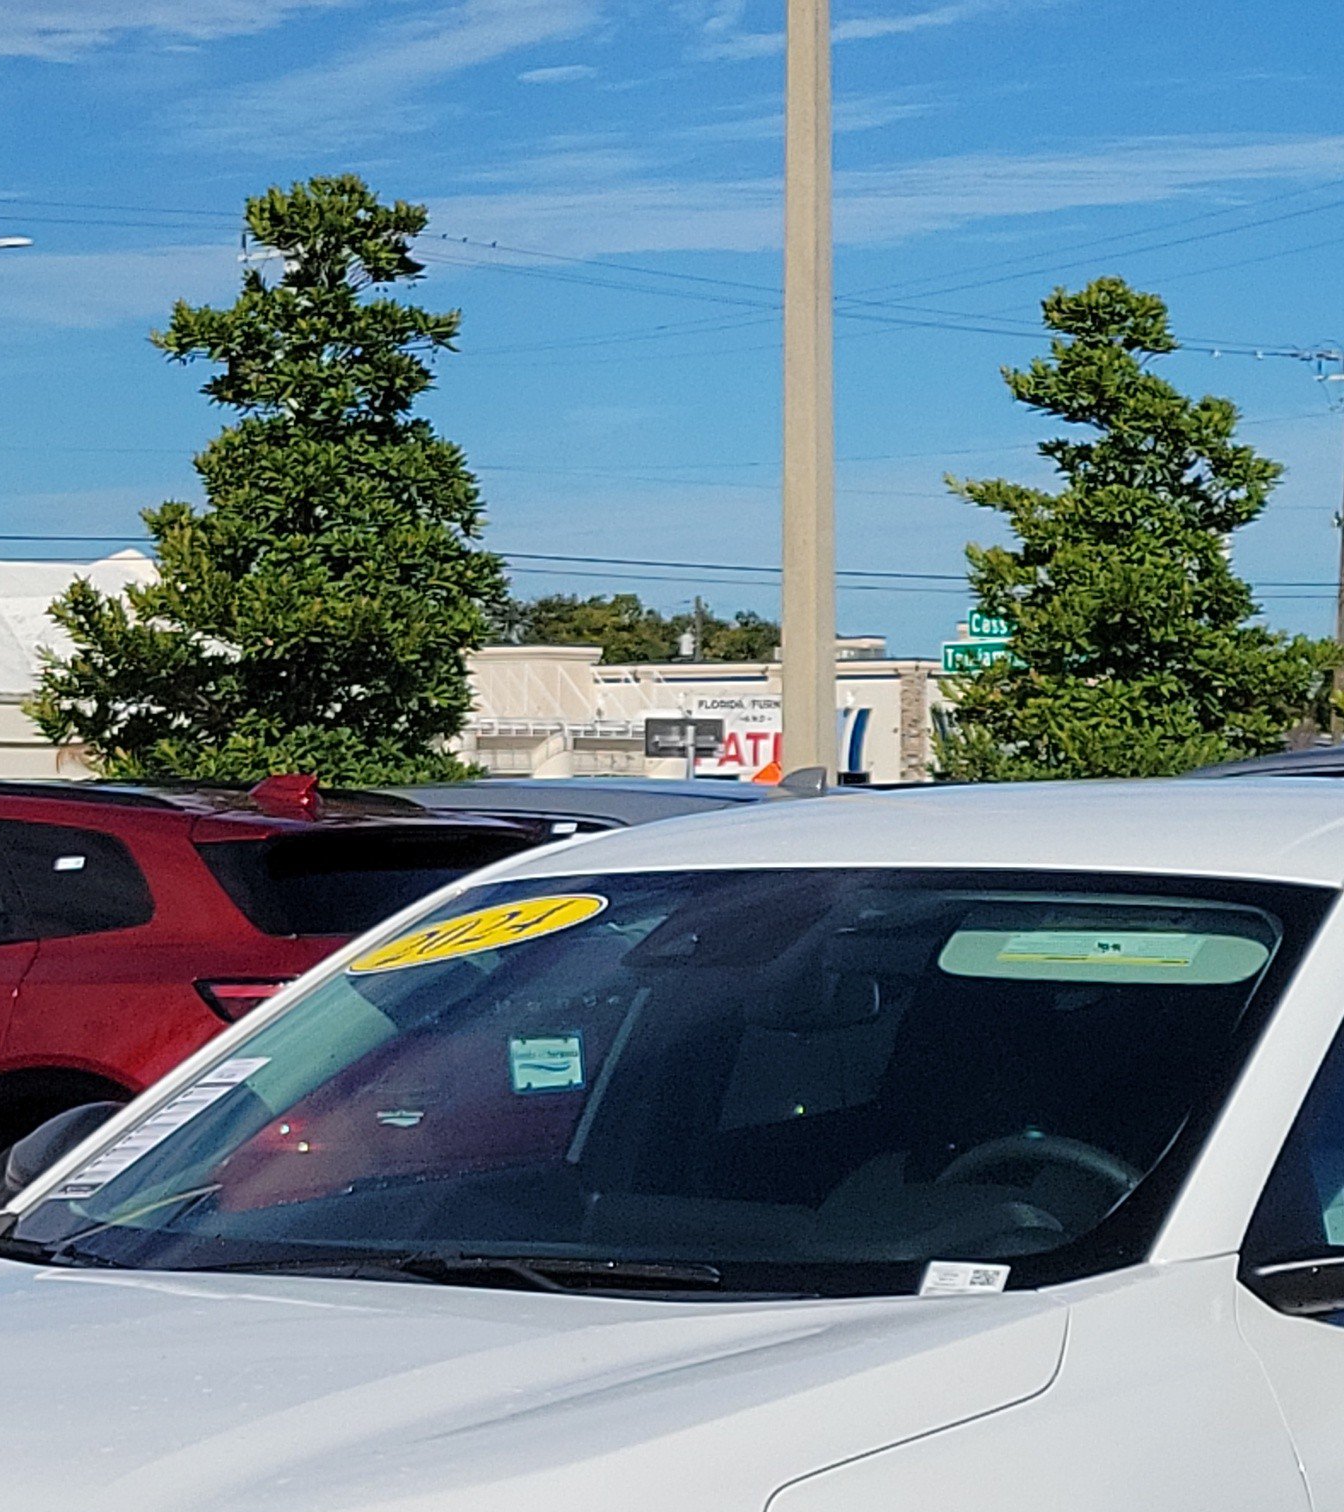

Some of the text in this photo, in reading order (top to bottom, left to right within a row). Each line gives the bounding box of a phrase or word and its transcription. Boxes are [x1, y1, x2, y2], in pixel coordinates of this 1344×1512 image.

[971, 613, 1008, 634] Cass
[698, 699, 745, 710] FLORIDA
[695, 731, 783, 767] ATI
[375, 900, 577, 966] 2024
